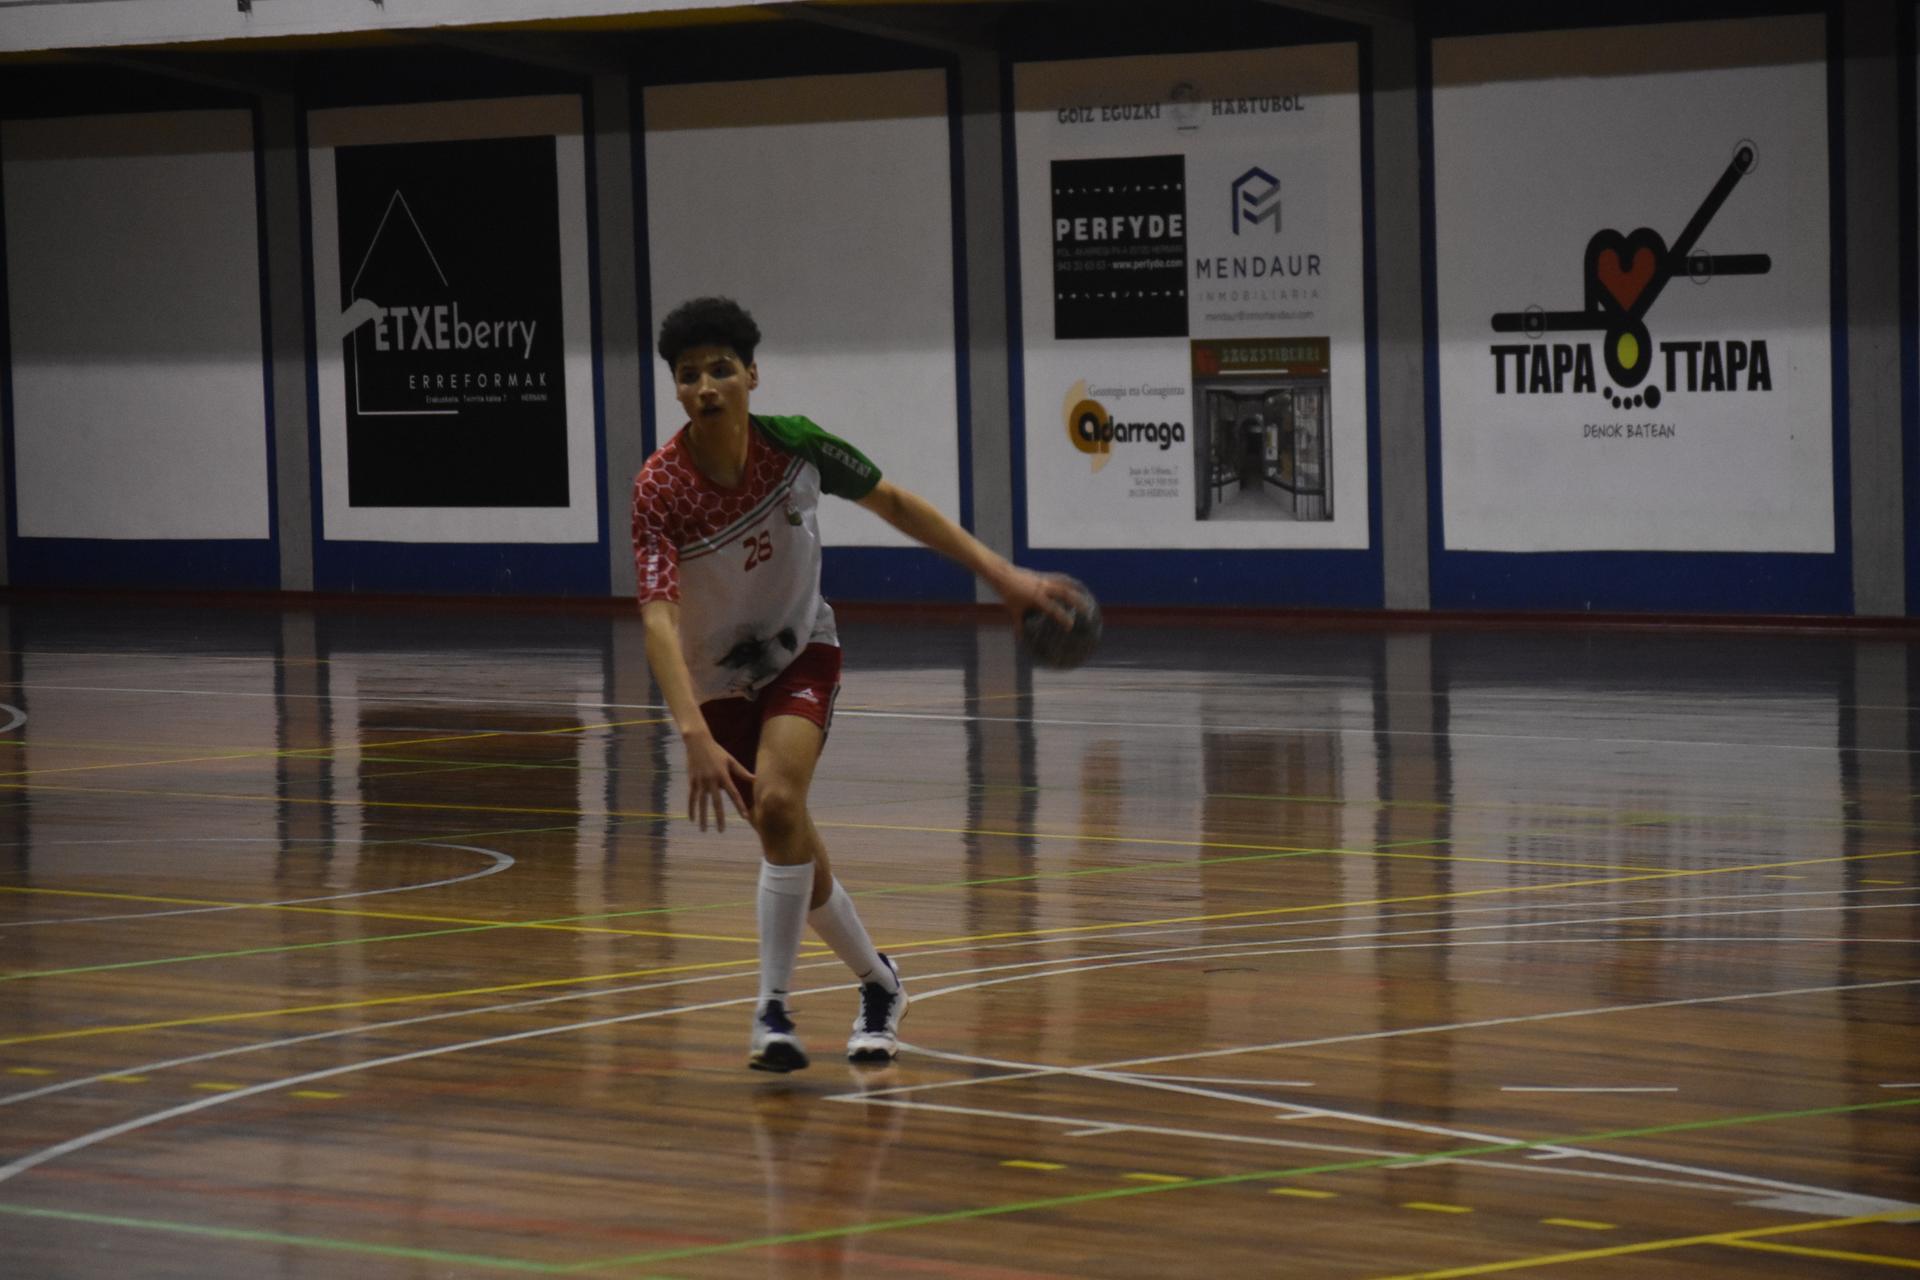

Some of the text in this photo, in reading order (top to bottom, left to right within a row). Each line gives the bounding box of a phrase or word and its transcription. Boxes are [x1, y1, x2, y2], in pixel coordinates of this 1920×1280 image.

[1057, 101, 1161, 124] GOIZ EGUZKI
[1211, 95, 1304, 116] HARTUBOL
[1056, 214, 1183, 241] PERFYDE
[1112, 259, 1183, 271] www.perfyde.com
[1196, 254, 1320, 279] MENDAUR
[1198, 289, 1320, 302] INMOBILIARIA
[374, 300, 537, 360] ETXEberry
[1491, 340, 1773, 394] TTAPA TTAPA
[409, 372, 547, 389] ERREFORMAK
[1583, 422, 1676, 439] DENOK BATEAN
[743, 531, 774, 571] 28
